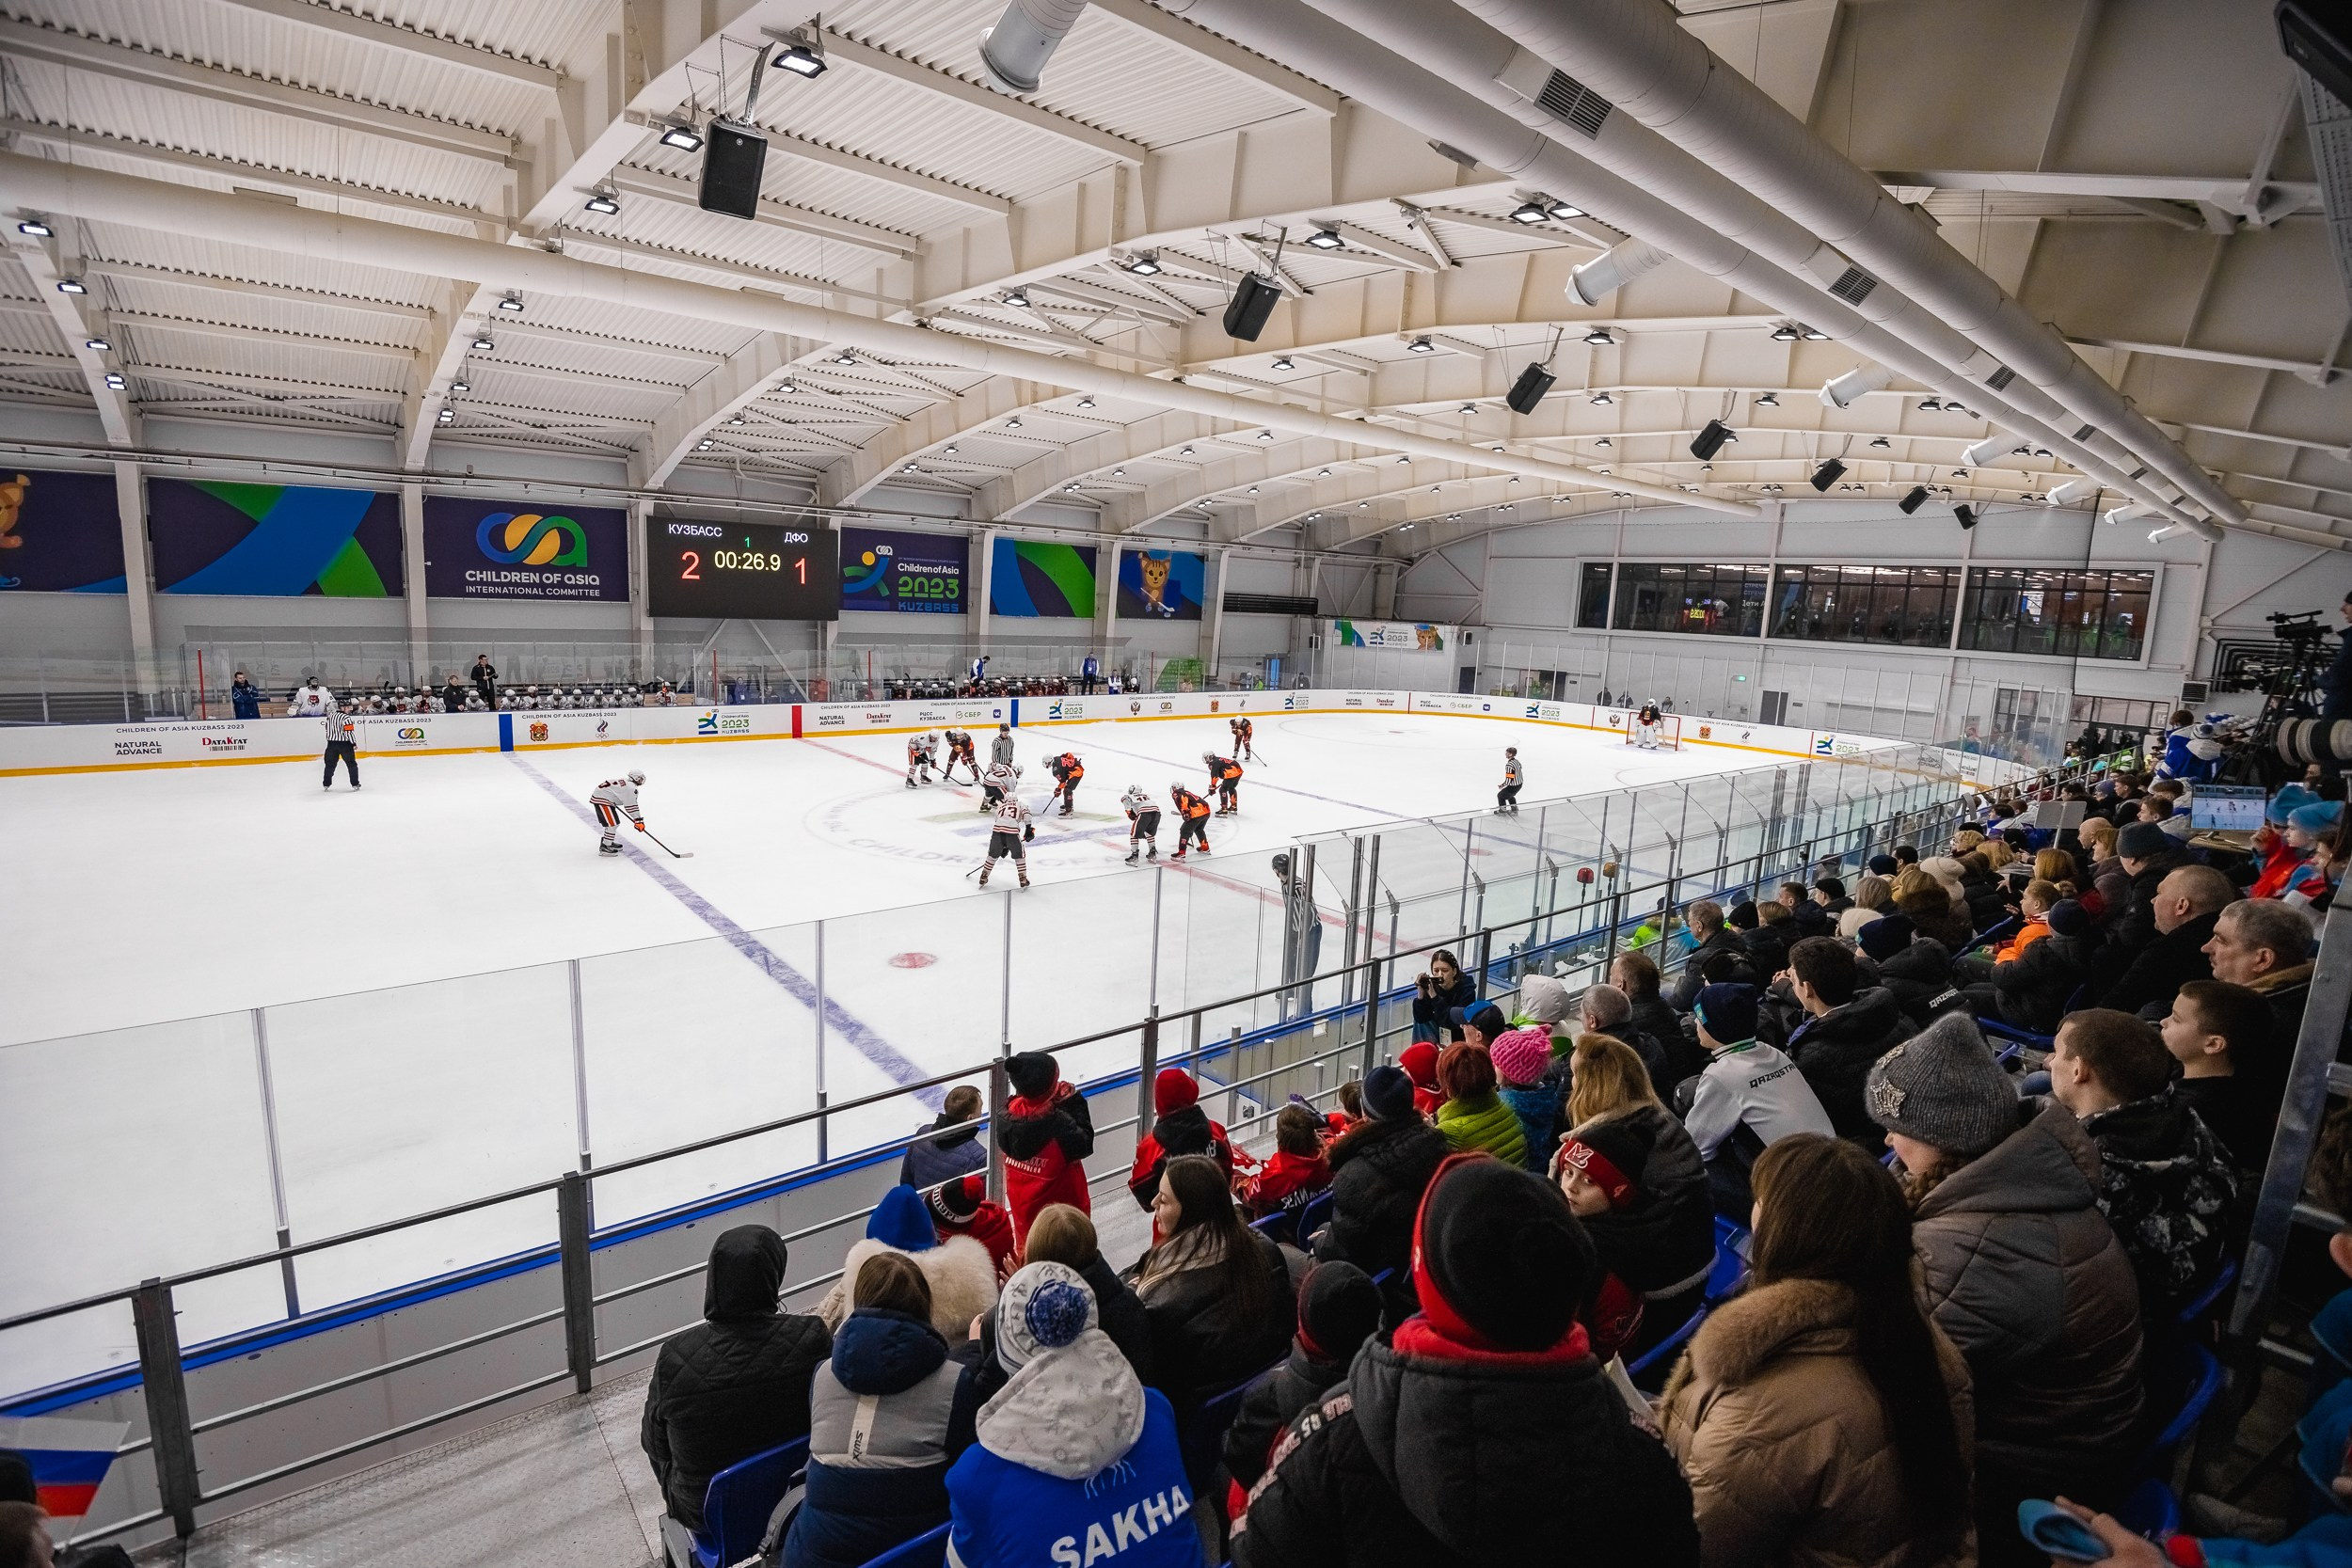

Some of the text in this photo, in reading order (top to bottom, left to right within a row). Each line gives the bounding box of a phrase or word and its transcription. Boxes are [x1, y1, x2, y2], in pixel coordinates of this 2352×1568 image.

[668, 523, 808, 543] КУЗБАСС ДФО
[744, 537, 750, 548] 1
[681, 551, 805, 584] 2 00:26.9 1
[898, 563, 959, 574] Children of Asia
[465, 570, 540, 583] CHILDREN
[542, 573, 561, 584] OF
[466, 586, 600, 596] INTERNATIONAL COMMITTEE
[898, 576, 959, 599] 2023
[898, 602, 959, 612] KUZBASS
[722, 719, 749, 728] 2023
[1050, 1485, 1190, 1568] SAKHA
